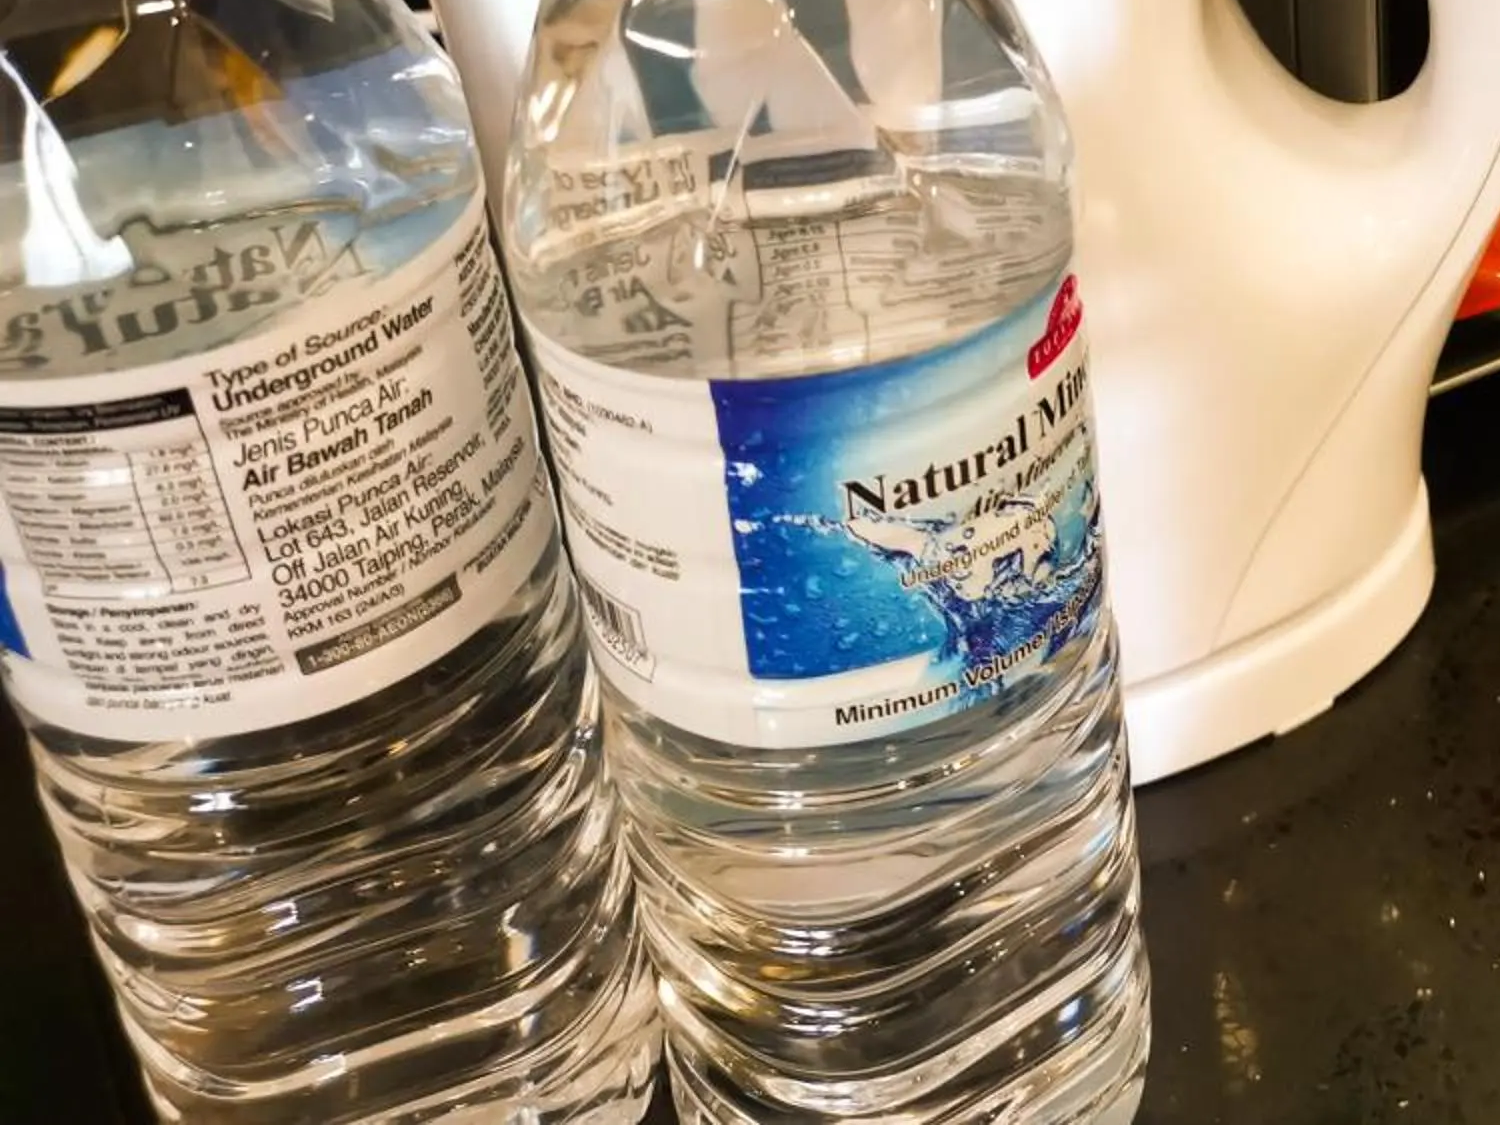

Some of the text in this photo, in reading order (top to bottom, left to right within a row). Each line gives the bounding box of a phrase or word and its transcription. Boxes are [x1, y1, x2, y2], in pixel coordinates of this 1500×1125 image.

[203, 305, 388, 391] Type of Source:
[212, 295, 434, 411] Underground Water
[234, 376, 410, 467] Jenis Punca Air:
[243, 388, 433, 492] Air Bawah Tanah
[257, 503, 333, 544] Lokasi
[338, 473, 401, 516] Punca
[844, 415, 1028, 521] Natural
[264, 536, 301, 563] Lot
[305, 518, 354, 550] 643,
[360, 488, 411, 527] Jalan
[272, 480, 468, 586] Off Jalan Air Kuning,
[900, 522, 1021, 588] Underground
[279, 569, 350, 609] 34000
[355, 533, 429, 577] Taiping,
[283, 590, 347, 624] Approval
[349, 570, 399, 600] Number
[835, 682, 958, 727] Minimum
[964, 632, 1043, 687] Volume
